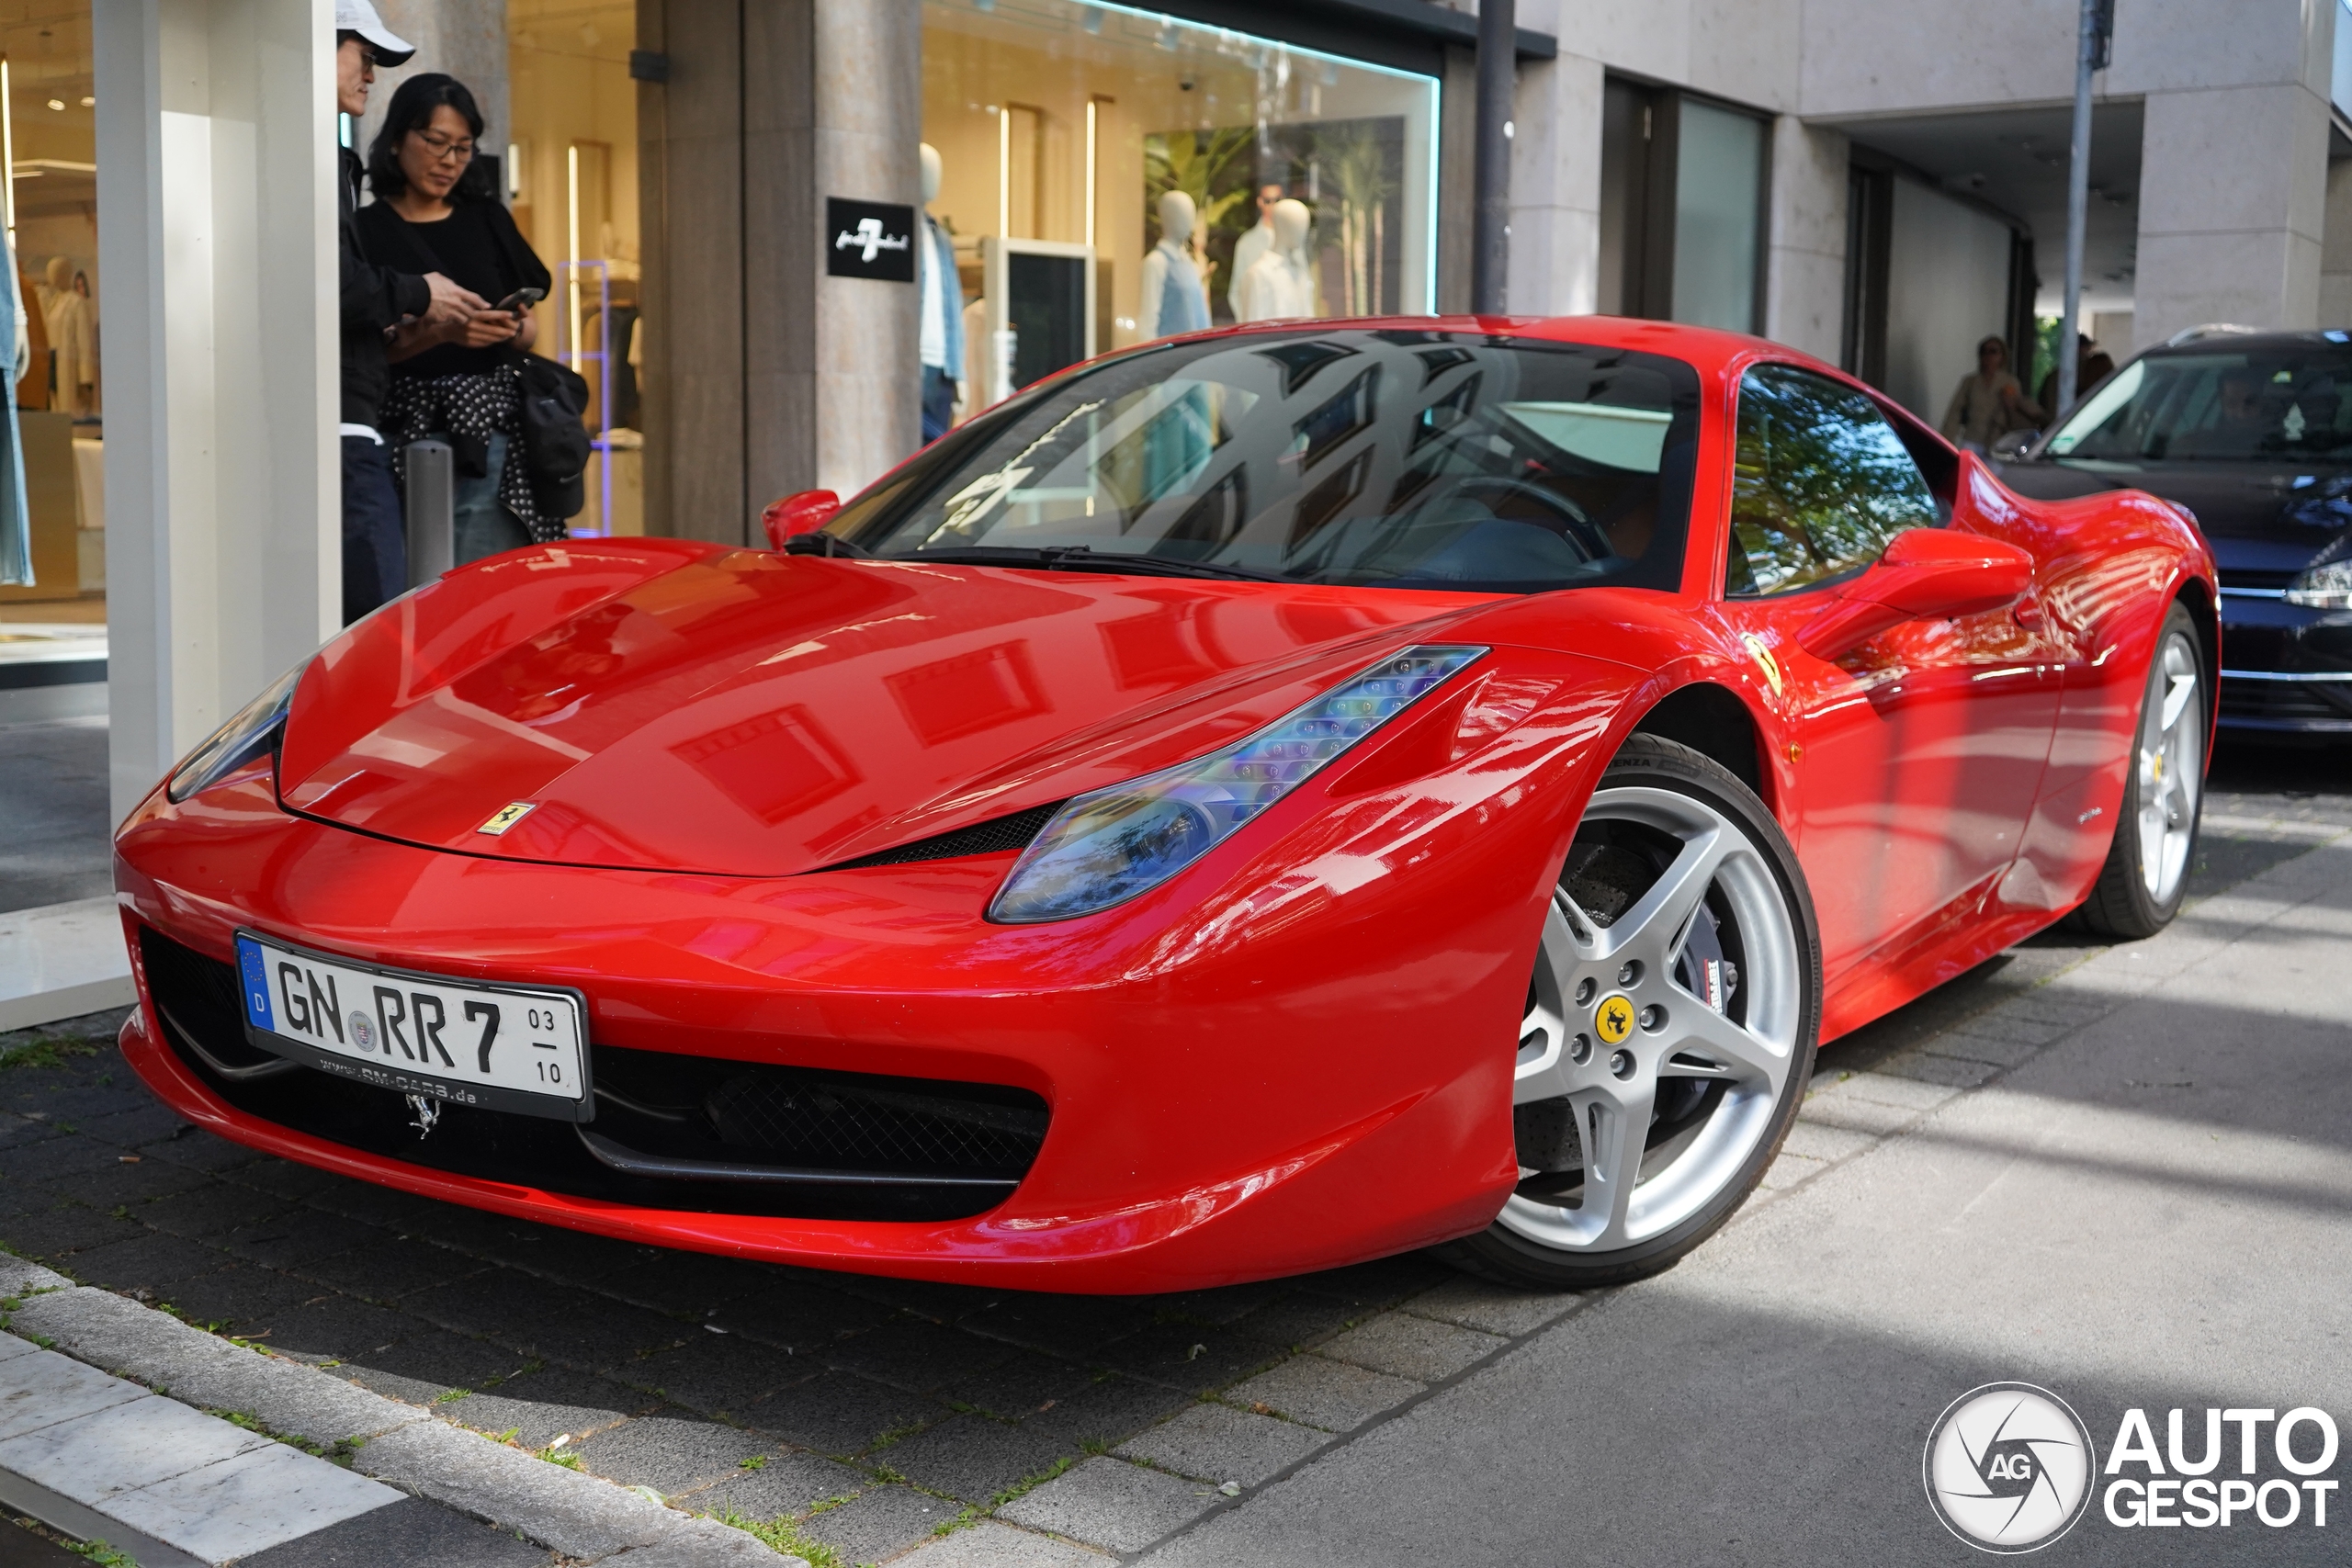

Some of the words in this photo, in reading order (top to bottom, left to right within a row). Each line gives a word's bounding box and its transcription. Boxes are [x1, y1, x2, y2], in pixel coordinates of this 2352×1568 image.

[857, 218, 884, 264] 7
[1662, 761, 1696, 776] SPORT
[254, 993, 266, 1013] D
[277, 960, 345, 1044] GN
[372, 985, 455, 1067] RR
[463, 999, 502, 1074] 7
[527, 1008, 555, 1032] 03
[537, 1061, 561, 1084] 10
